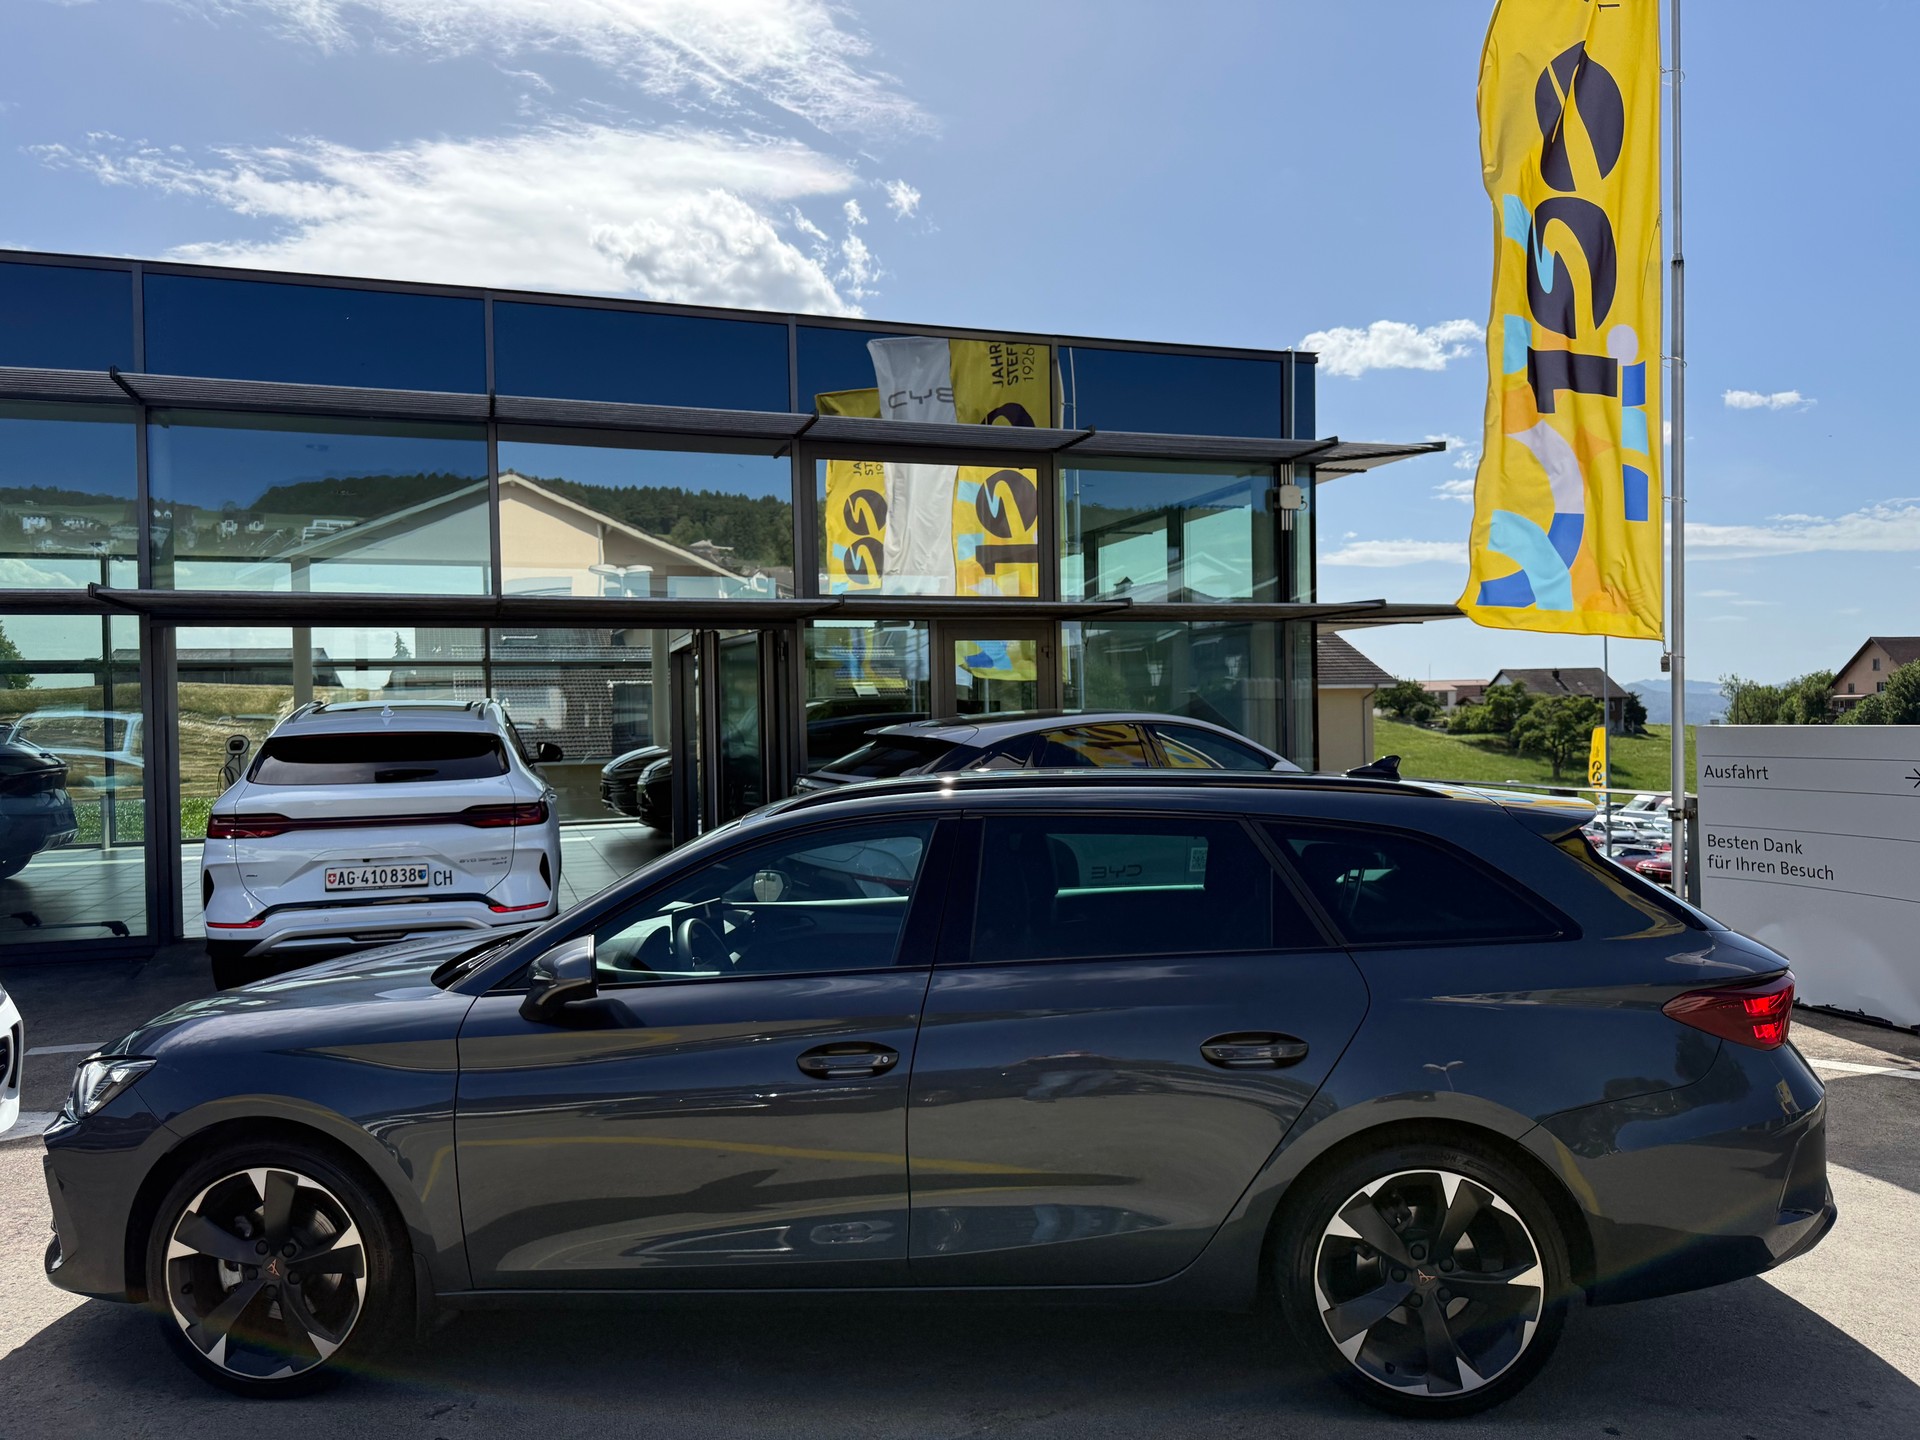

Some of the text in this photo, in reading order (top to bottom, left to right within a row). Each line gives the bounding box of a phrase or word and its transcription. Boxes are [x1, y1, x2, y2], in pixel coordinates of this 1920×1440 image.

[989, 340, 1004, 388] JAHR
[1005, 341, 1019, 386] STEF
[1703, 764, 1769, 781] Ausfahrt
[1707, 833, 1803, 855] Besten Dank
[433, 870, 453, 886] CH
[1090, 864, 1143, 880] BYD
[1706, 854, 1834, 881] für Ihren Besuch
